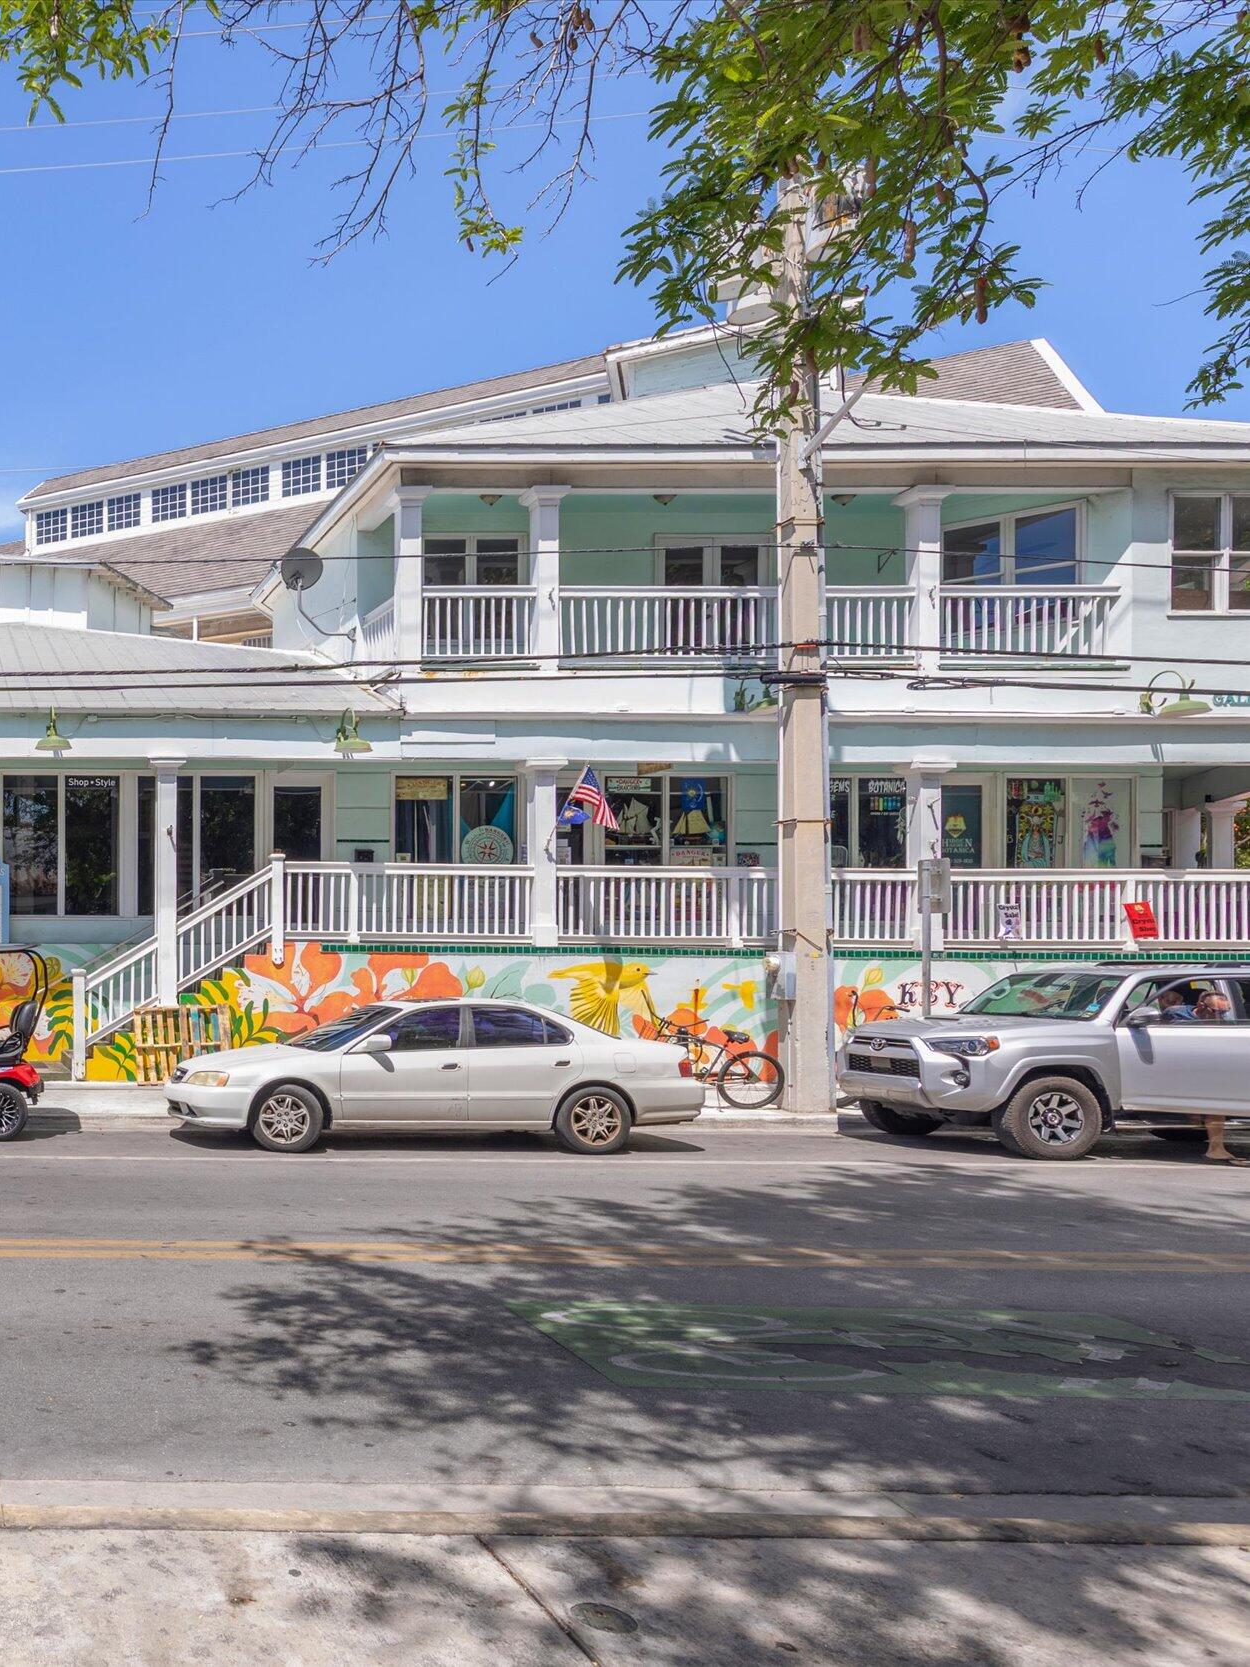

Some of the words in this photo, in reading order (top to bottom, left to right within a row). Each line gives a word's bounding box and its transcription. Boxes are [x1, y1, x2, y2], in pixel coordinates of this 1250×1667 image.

[68, 777, 89, 787] Shop
[95, 778, 116, 788] Style
[868, 780, 907, 794] BOTANICA
